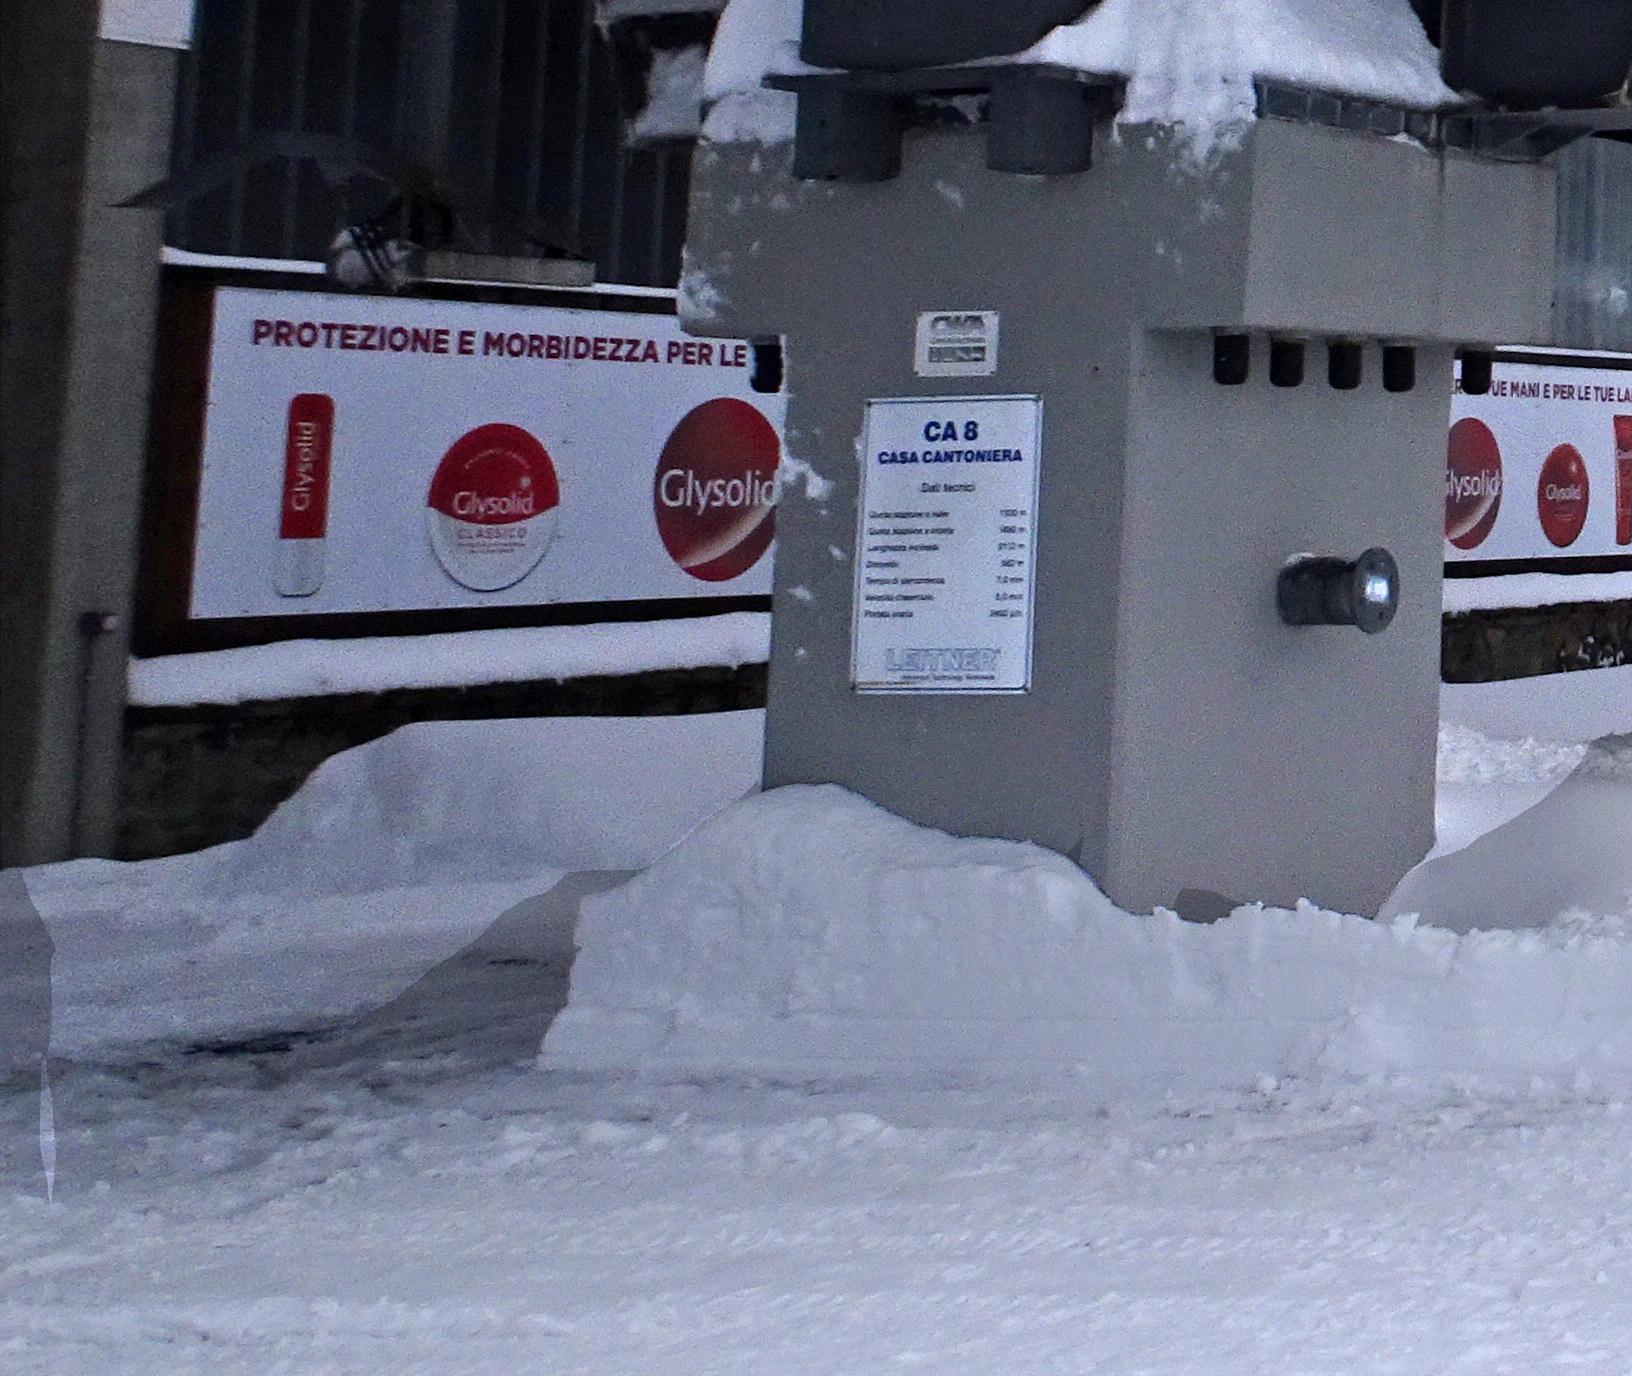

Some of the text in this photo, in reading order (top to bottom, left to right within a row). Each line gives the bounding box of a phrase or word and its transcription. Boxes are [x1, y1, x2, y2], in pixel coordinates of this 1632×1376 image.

[252, 319, 747, 367] PROTEZIONE E MORBIDEZZA PER LE
[1487, 380, 1507, 396] UE
[1510, 381, 1539, 398] MANI
[1543, 383, 1550, 399] E
[1553, 384, 1575, 400] PER
[1578, 385, 1591, 401] LE
[1594, 386, 1614, 402] TUE
[924, 421, 978, 442] CA 8
[291, 421, 317, 511] Glysolid
[878, 449, 1022, 465] CASA CANTONIERA
[659, 468, 778, 516] Glysolid
[1449, 469, 1500, 503] lysolid
[452, 490, 534, 519] Glysolid
